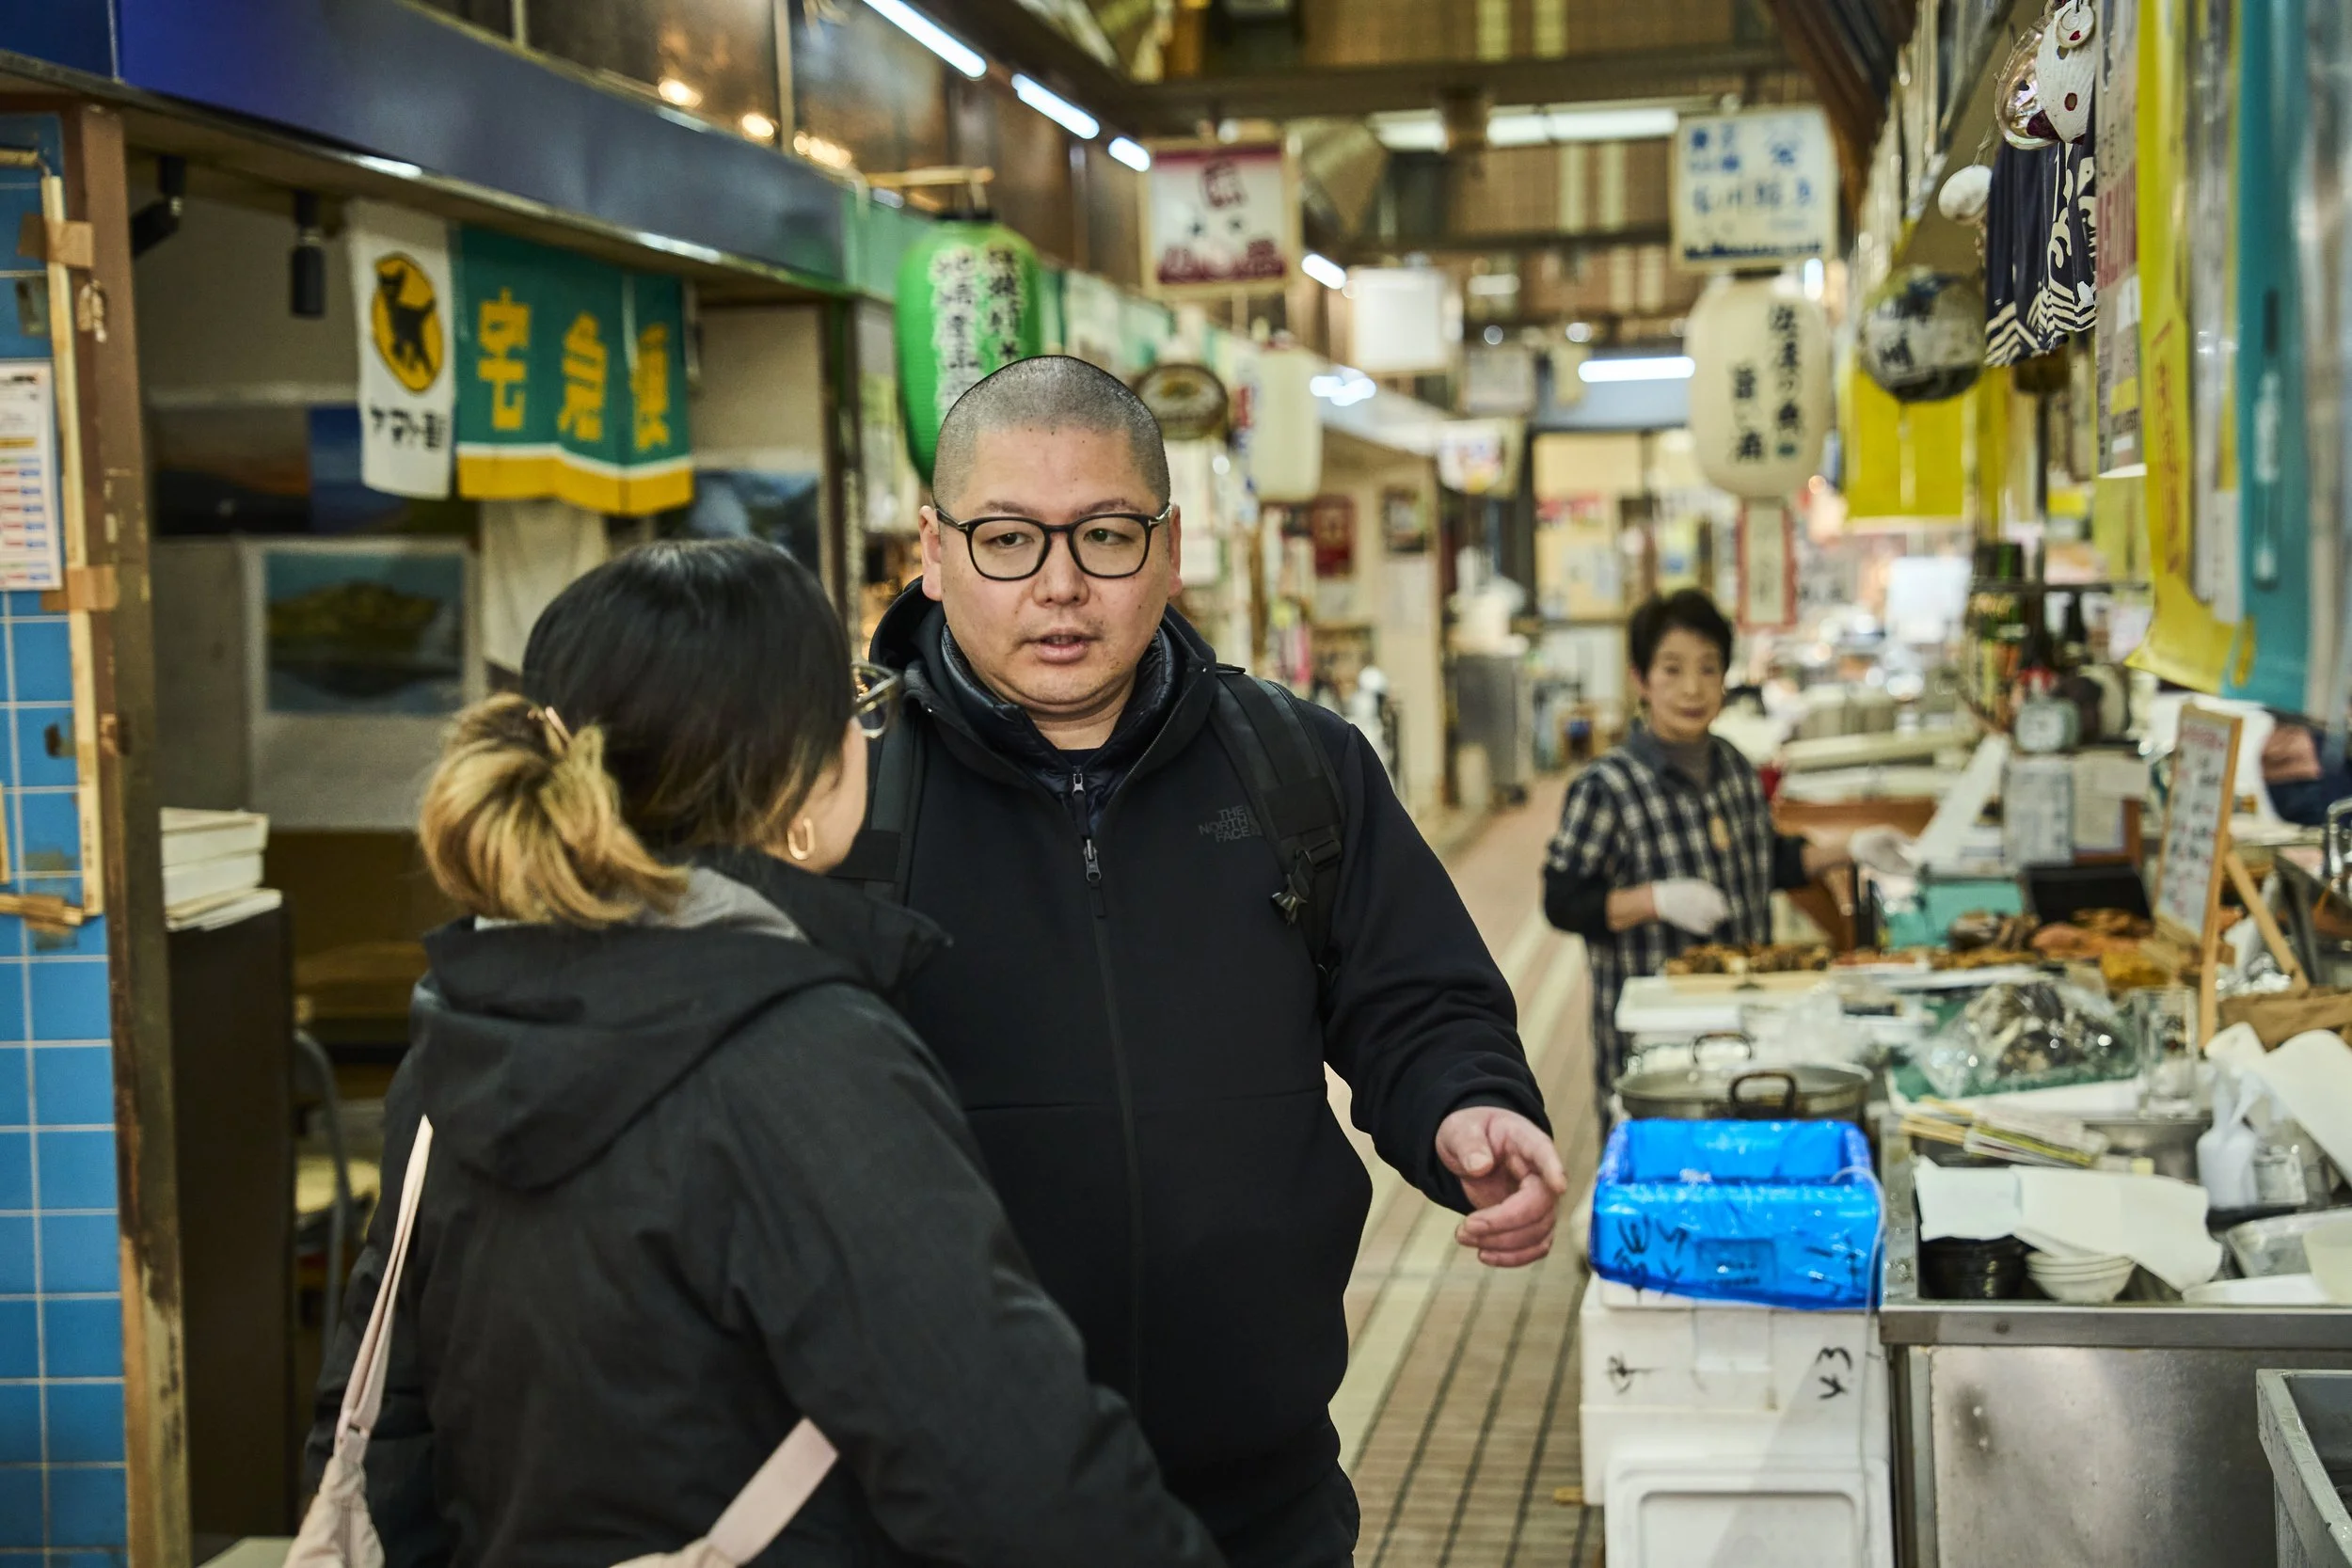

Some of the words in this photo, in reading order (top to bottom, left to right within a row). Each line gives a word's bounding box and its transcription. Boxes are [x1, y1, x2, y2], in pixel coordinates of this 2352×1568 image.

[1216, 805, 1246, 821] THE
[1198, 815, 1249, 836] NORTH
[1215, 826, 1250, 843] FACE
